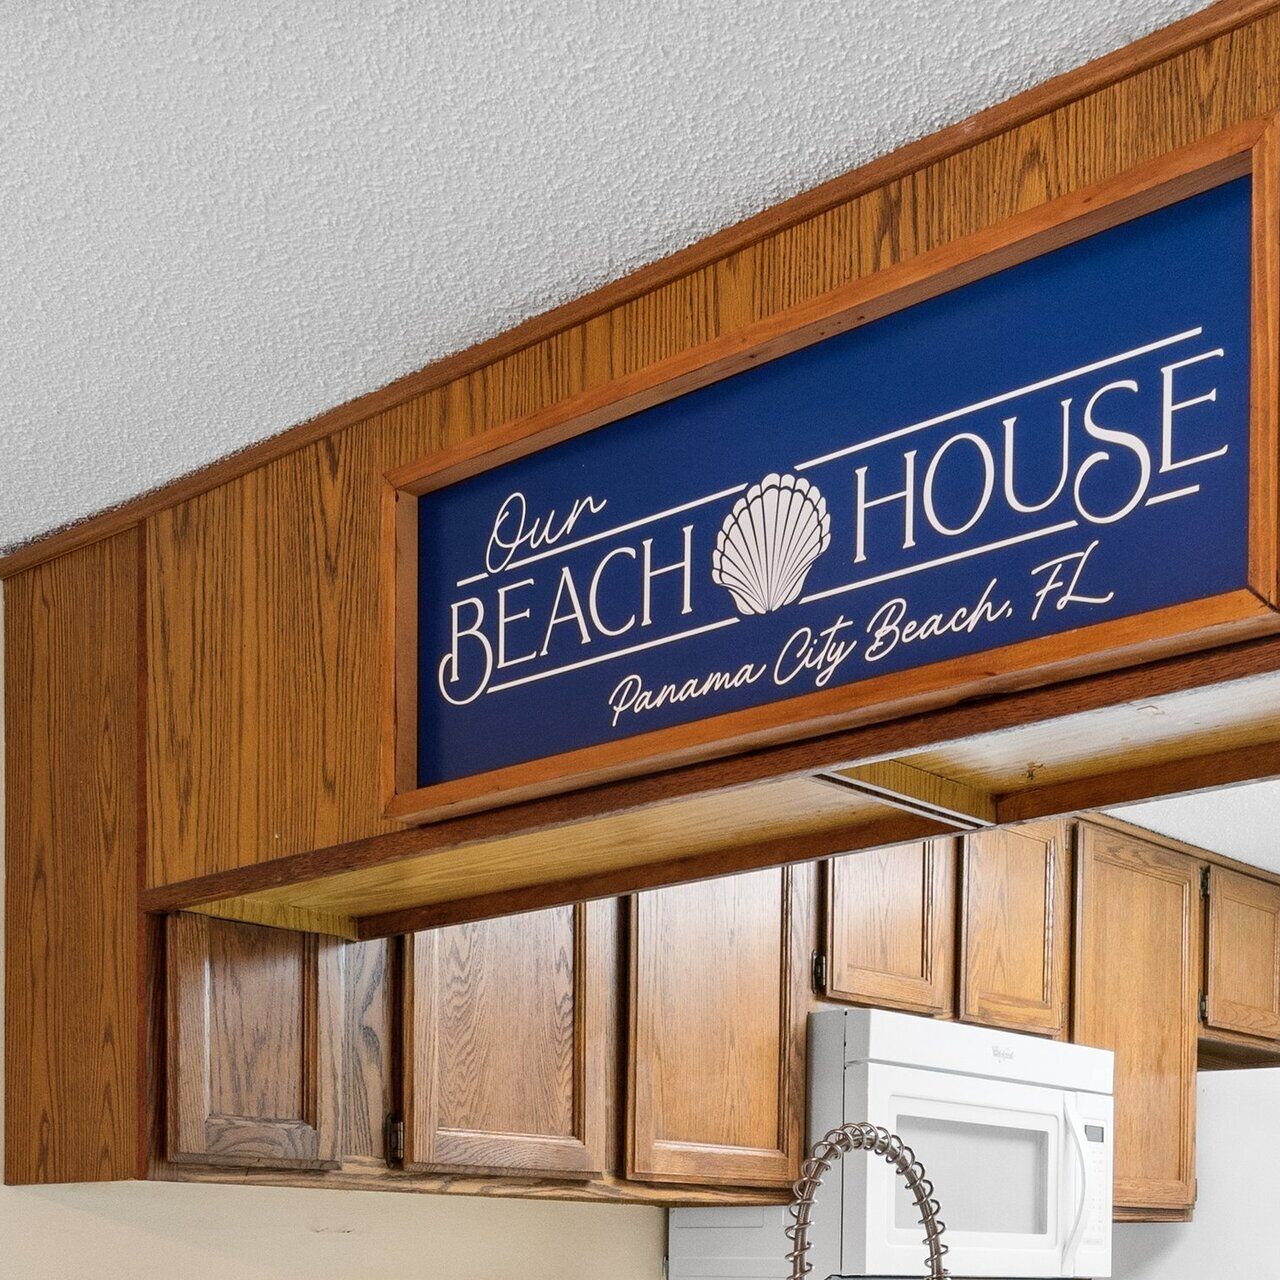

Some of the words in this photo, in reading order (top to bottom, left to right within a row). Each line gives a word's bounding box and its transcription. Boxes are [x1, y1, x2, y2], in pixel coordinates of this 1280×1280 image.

[438, 524, 694, 706] BEACH
[853, 348, 1229, 564] HOUSE
[485, 492, 607, 574] Our
[608, 663, 767, 727] Panama
[773, 613, 858, 687] City
[1030, 539, 1115, 621] FL
